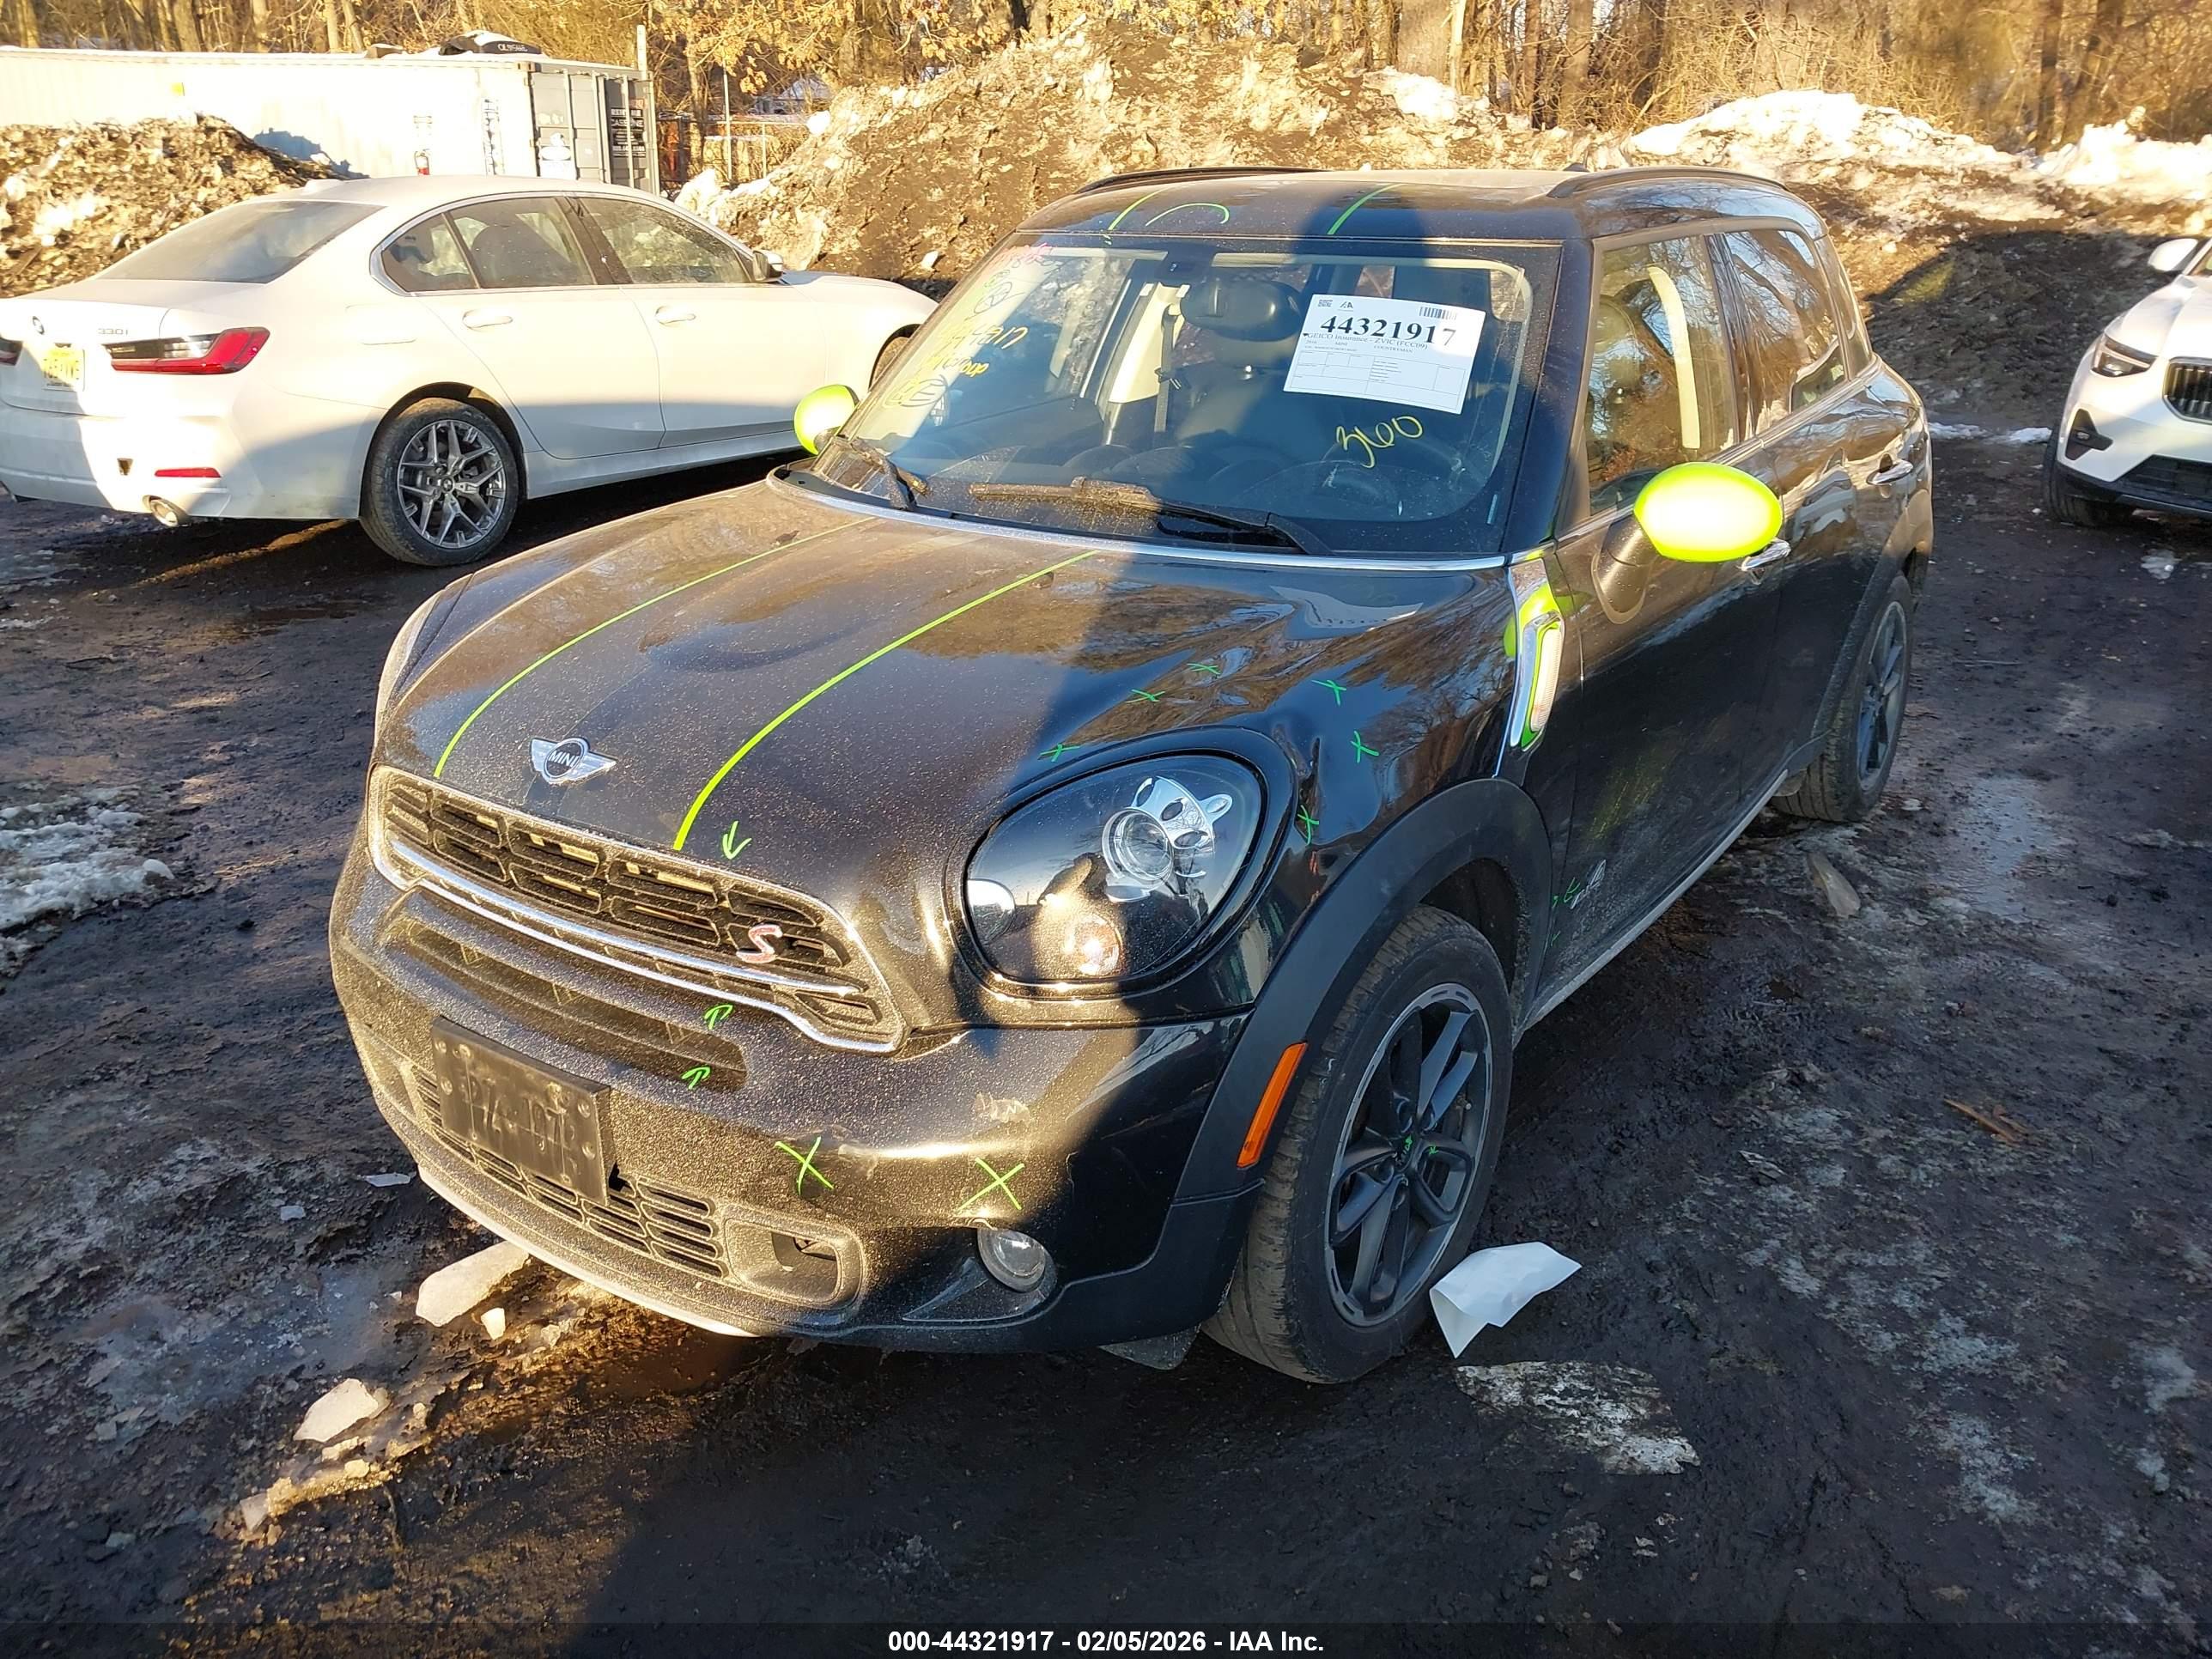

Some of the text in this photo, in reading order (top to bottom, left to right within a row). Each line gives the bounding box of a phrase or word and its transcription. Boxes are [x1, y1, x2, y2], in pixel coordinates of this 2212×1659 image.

[1320, 315, 1457, 346] 44321917
[549, 750, 580, 768] MINI
[736, 923, 783, 963] S
